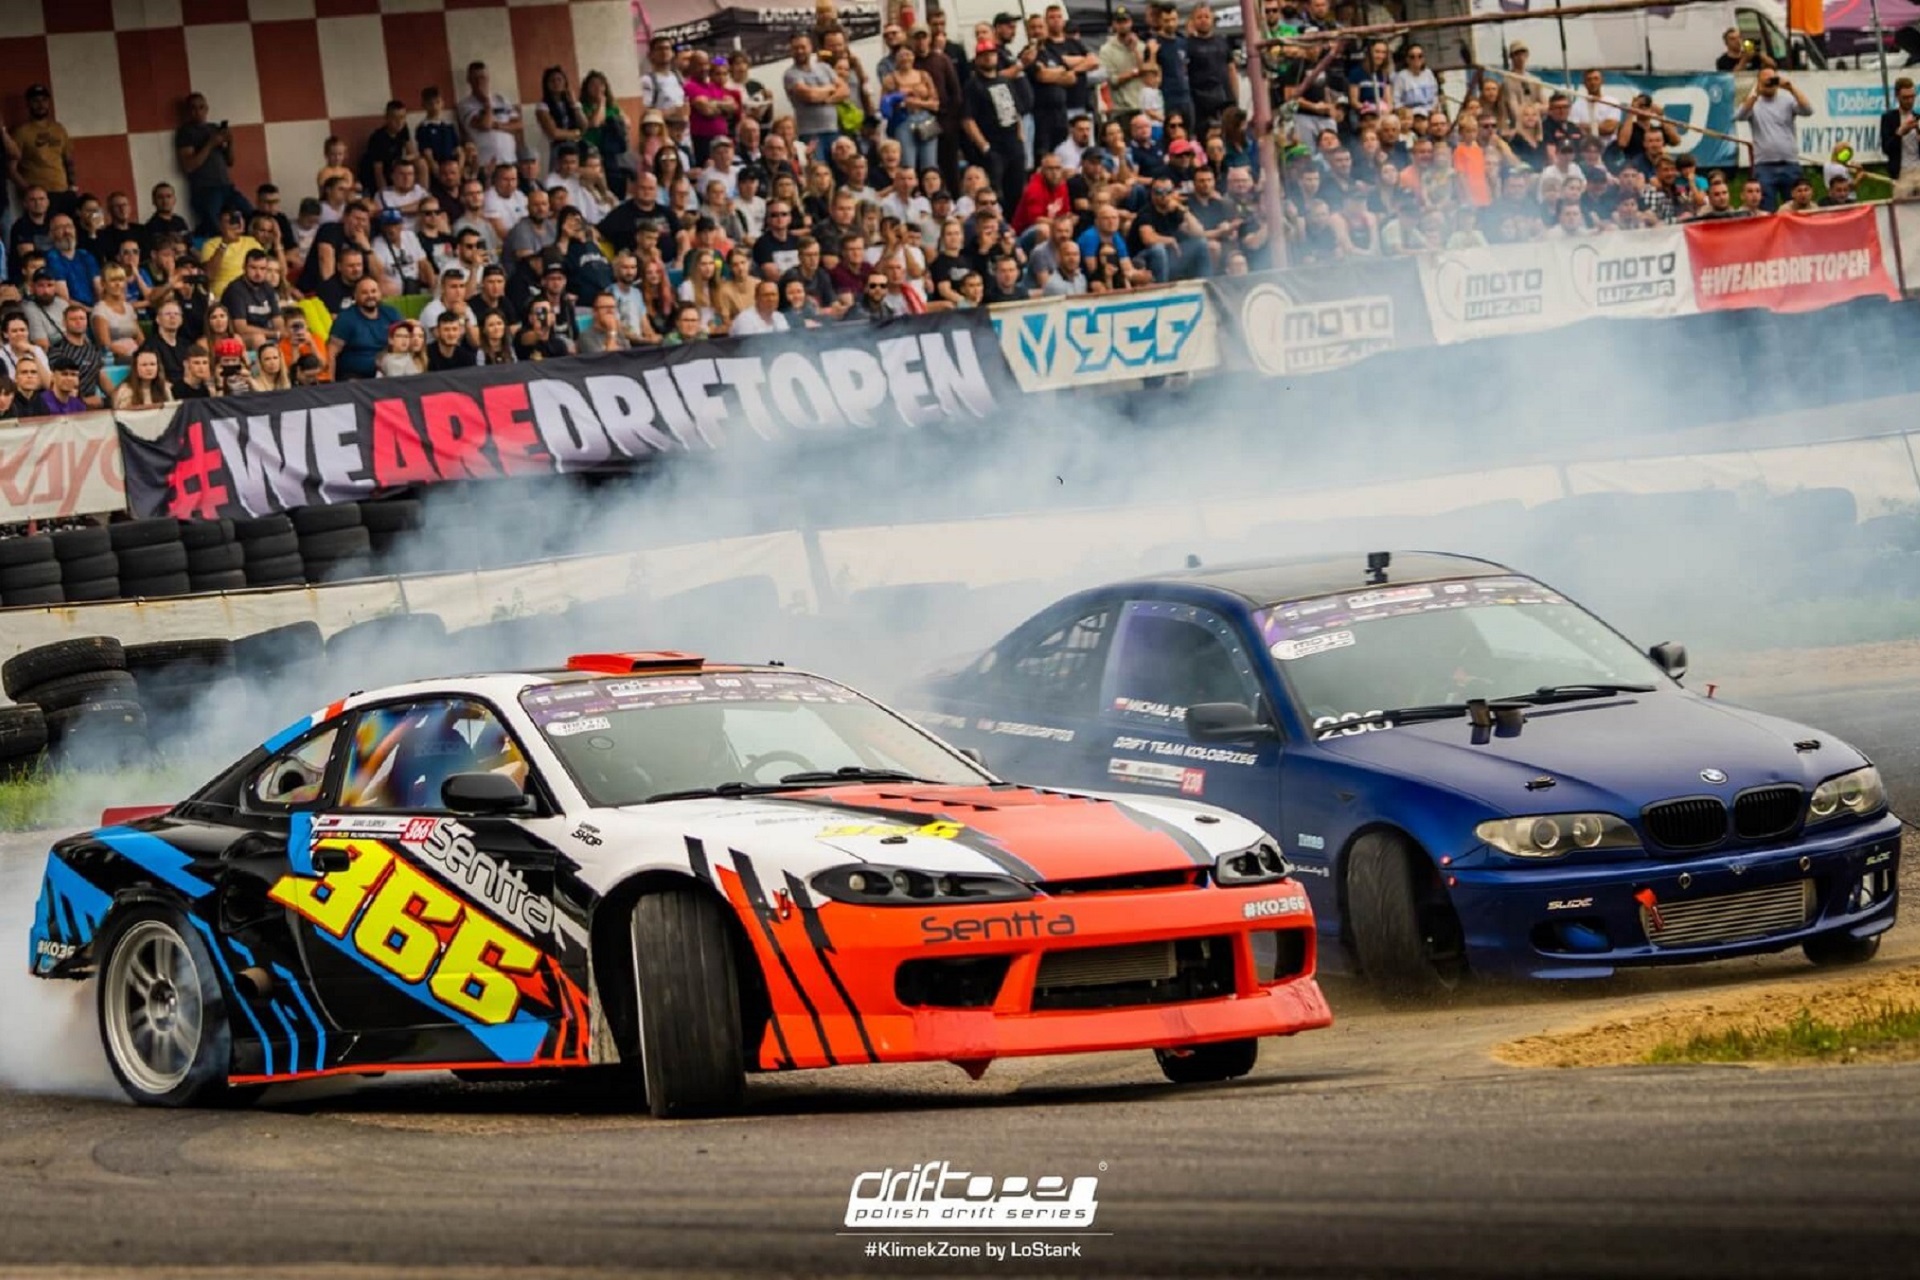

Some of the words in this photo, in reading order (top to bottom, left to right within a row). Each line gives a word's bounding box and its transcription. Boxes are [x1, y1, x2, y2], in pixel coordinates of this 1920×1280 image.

[1802, 124, 1883, 154] WYTRZYM
[1466, 269, 1543, 298] MOTO
[1597, 252, 1677, 283] MOTO
[1700, 248, 1871, 296] #WEAREDRIFTOPEN
[1285, 302, 1389, 341] MOTO
[168, 329, 996, 521] #WEAREDRIFTOPEN
[1113, 736, 1150, 751] DRIFT
[1149, 741, 1185, 756] TEAM
[571, 829, 603, 847] SHOP
[421, 817, 556, 935] Sentta
[268, 836, 544, 1025] 366
[921, 912, 1076, 944] Sentta
